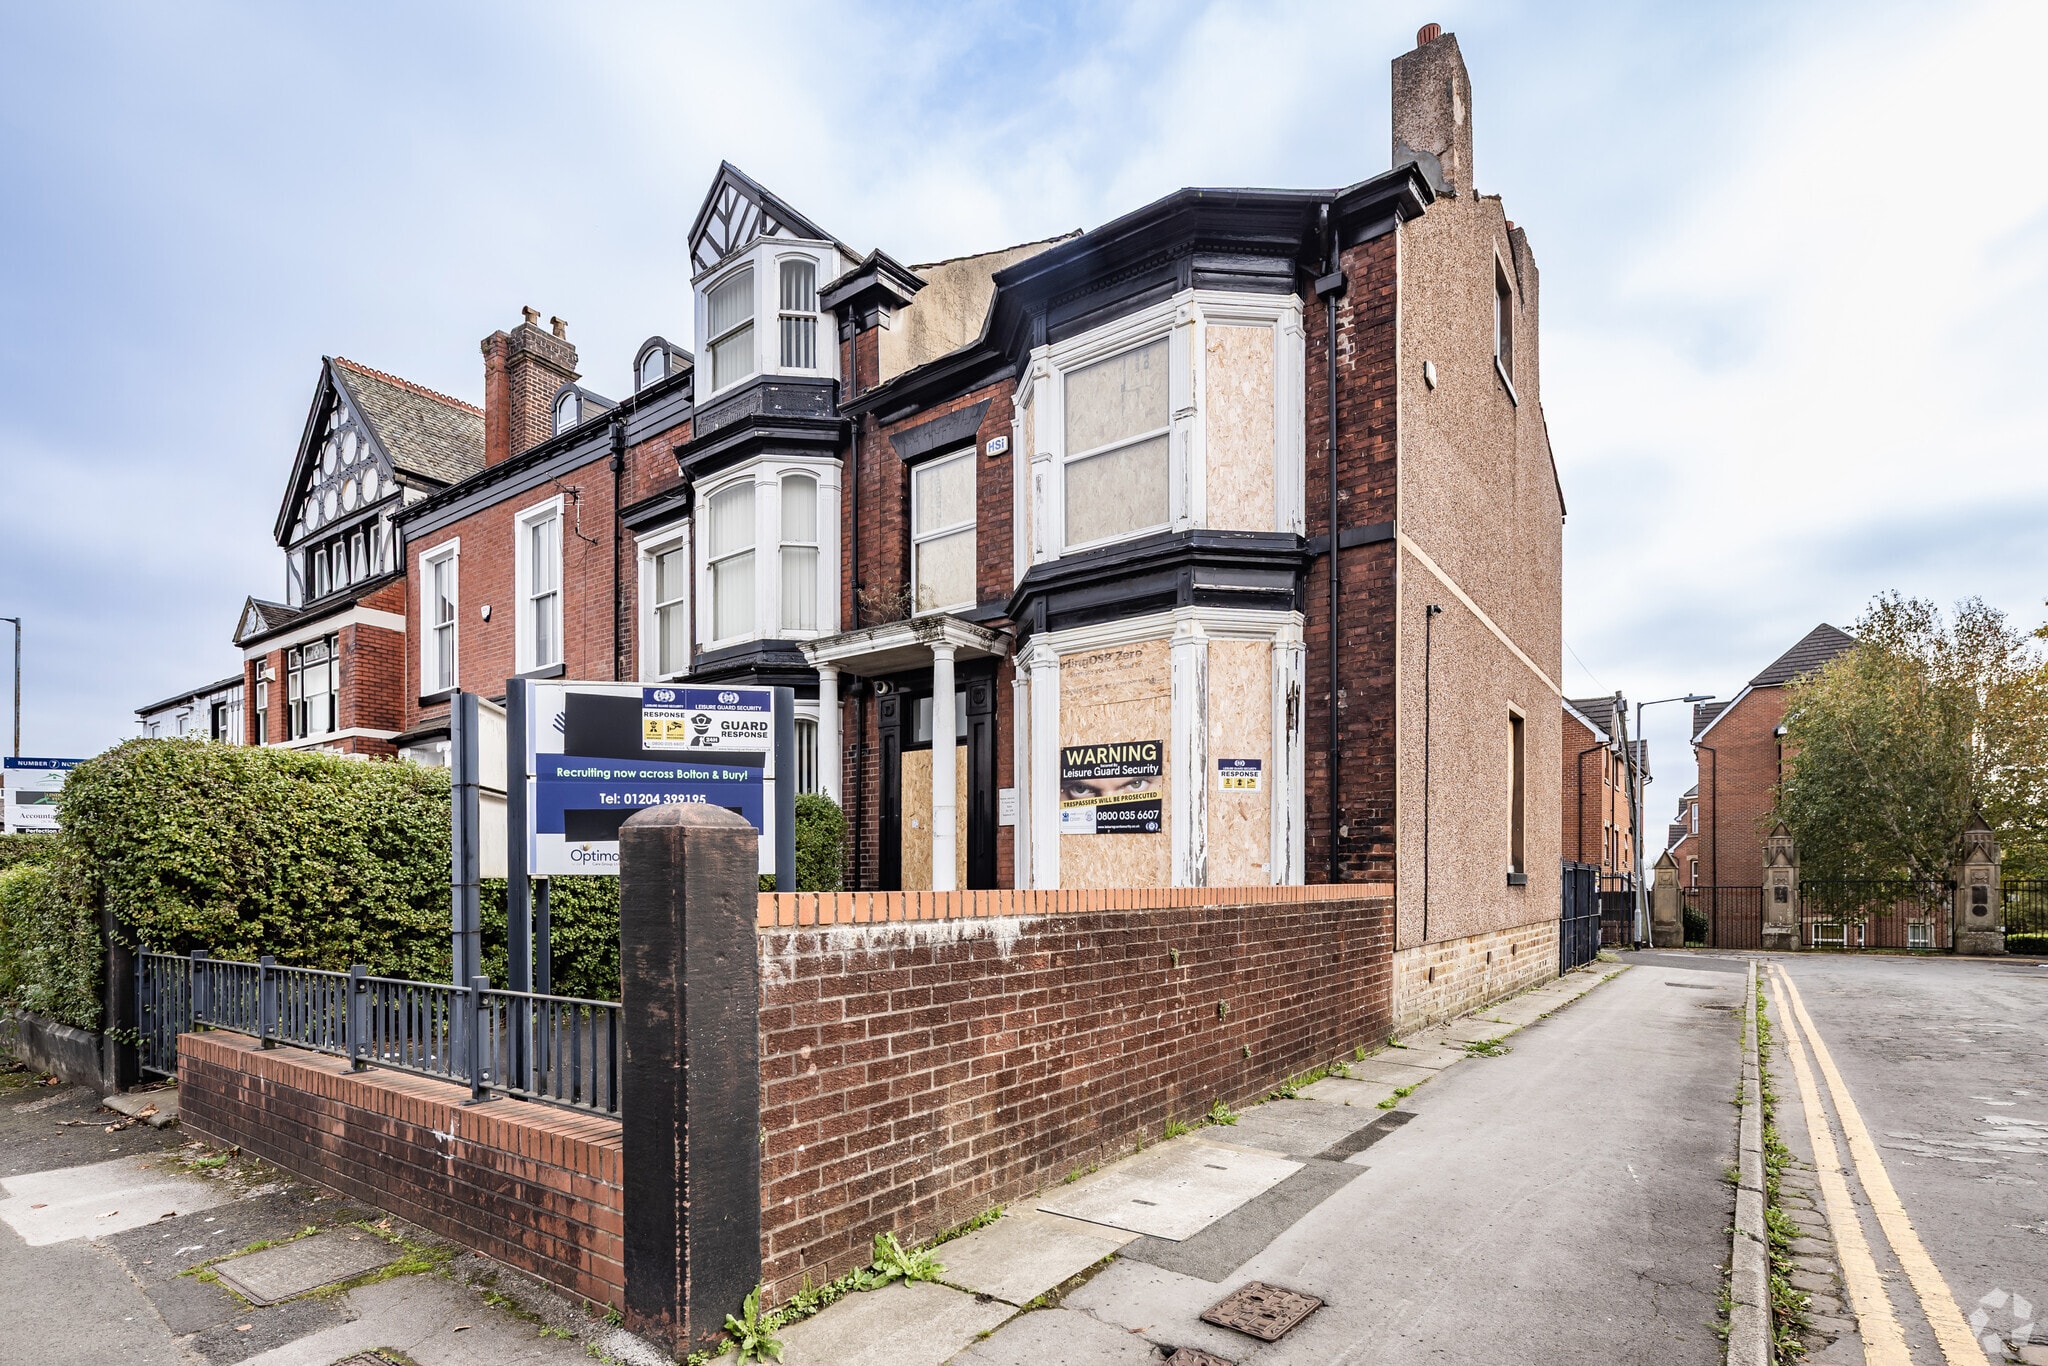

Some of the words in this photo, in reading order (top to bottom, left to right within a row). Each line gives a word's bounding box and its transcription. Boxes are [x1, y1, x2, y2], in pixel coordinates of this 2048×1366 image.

[1114, 650, 1143, 662] Zero
[721, 721, 768, 731] GUARD
[1066, 744, 1157, 765] WARNING
[556, 768, 610, 779] Recruiting
[677, 770, 708, 779] Bolton
[712, 771, 719, 779] &
[723, 771, 748, 782] Bury!
[1064, 768, 1092, 778] Leisure
[1094, 766, 1120, 776] Guard
[1122, 764, 1159, 775] Security
[600, 793, 620, 804] Tel:
[624, 794, 660, 804] 01204
[664, 794, 706, 804] 399195
[1064, 799, 1097, 808] TRESPASSERS
[1121, 792, 1158, 801] PROSECUTED
[1097, 812, 1118, 820] 0800
[1119, 811, 1135, 820] 035
[1137, 810, 1159, 820] 6607
